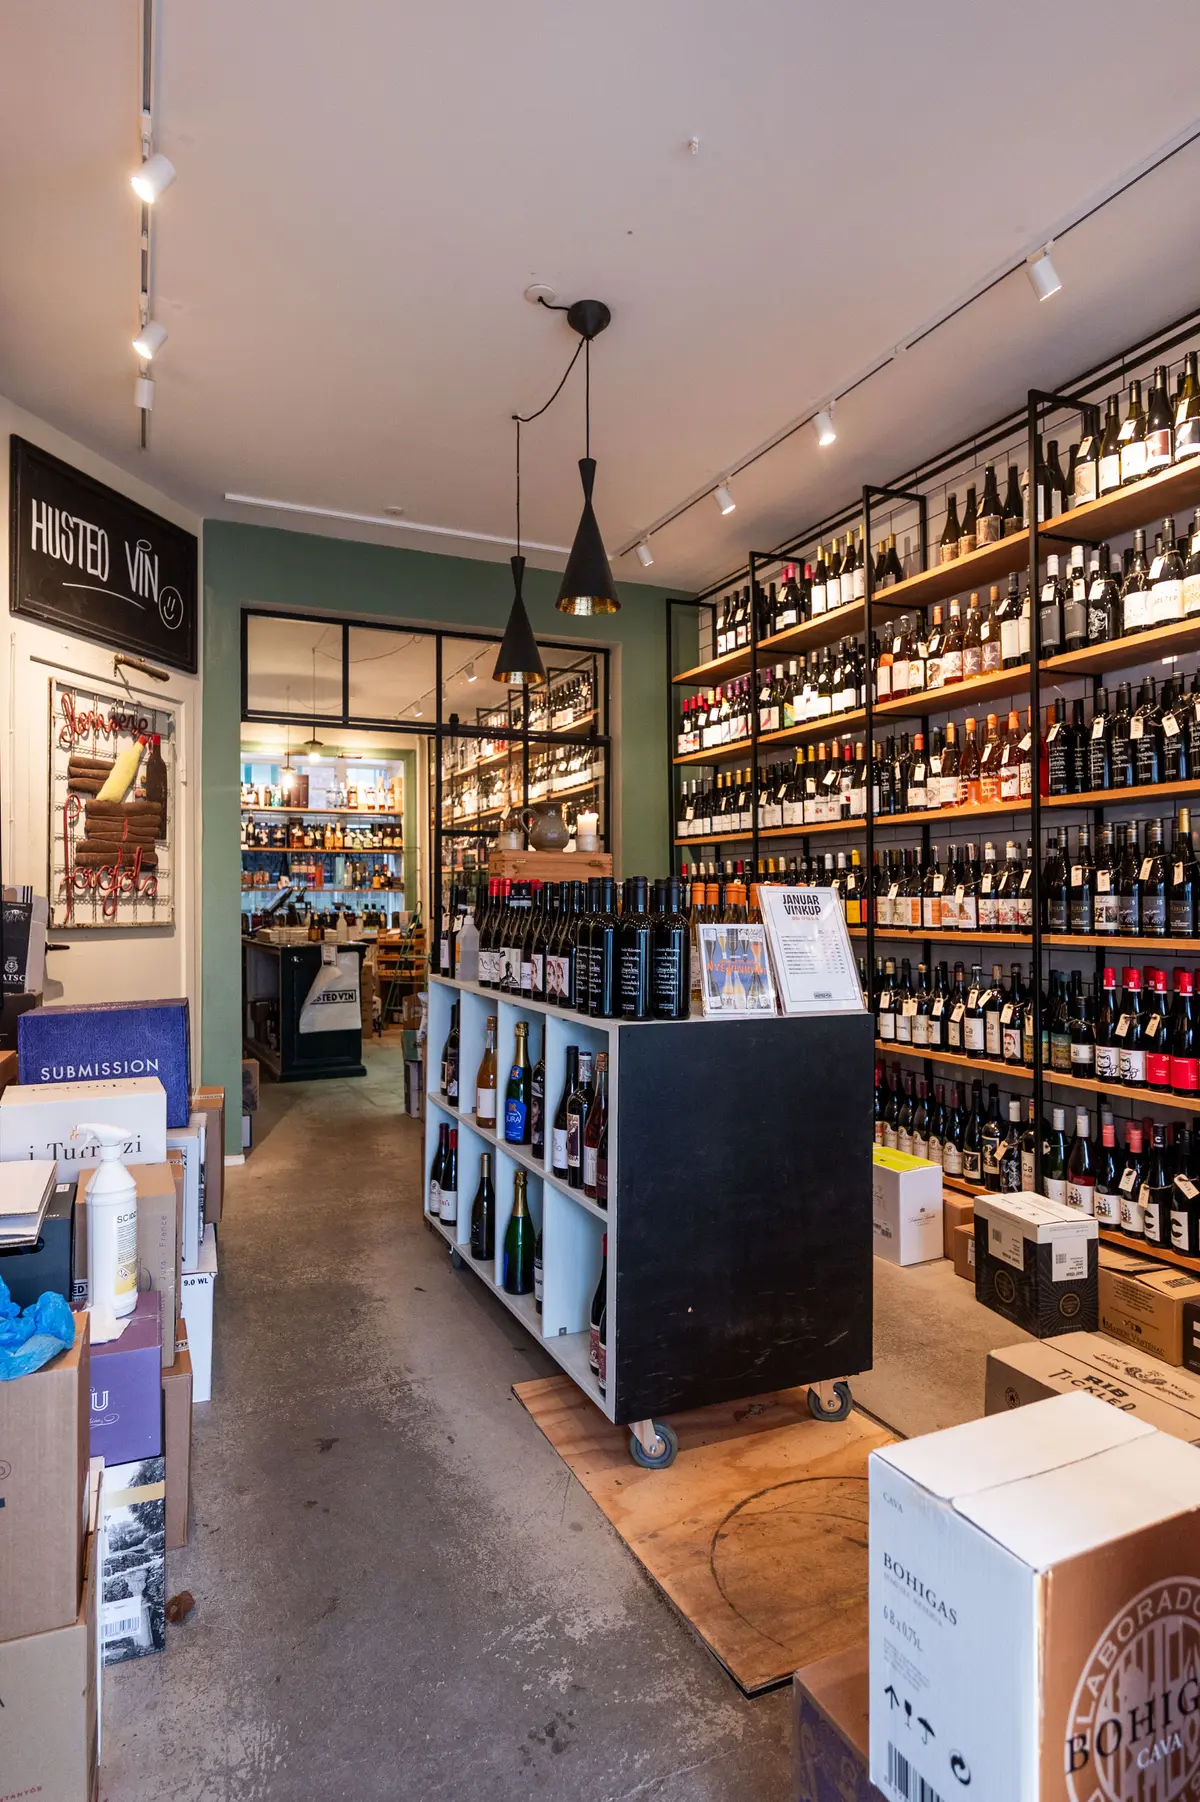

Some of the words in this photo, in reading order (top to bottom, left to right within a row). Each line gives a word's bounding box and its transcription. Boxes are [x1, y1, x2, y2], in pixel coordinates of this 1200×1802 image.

[31, 498, 110, 582] HUSTED
[124, 540, 159, 603] VIN
[782, 894, 819, 906] JANUAR
[784, 904, 822, 916] VINKUP
[40, 1058, 160, 1081] SUBMISSION
[1022, 1162, 1033, 1173] Ca
[159, 1215, 167, 1248] France
[184, 1278, 196, 1287] 9.0
[197, 1277, 209, 1286] WL
[1048, 1368, 1138, 1412] TICKLED
[1083, 1374, 1130, 1399] RIB
[1170, 1383, 1196, 1399] WINE
[883, 1491, 904, 1514] CAVA
[883, 1551, 957, 1626] BOHIGAS
[1136, 1732, 1182, 1770] CAVA
